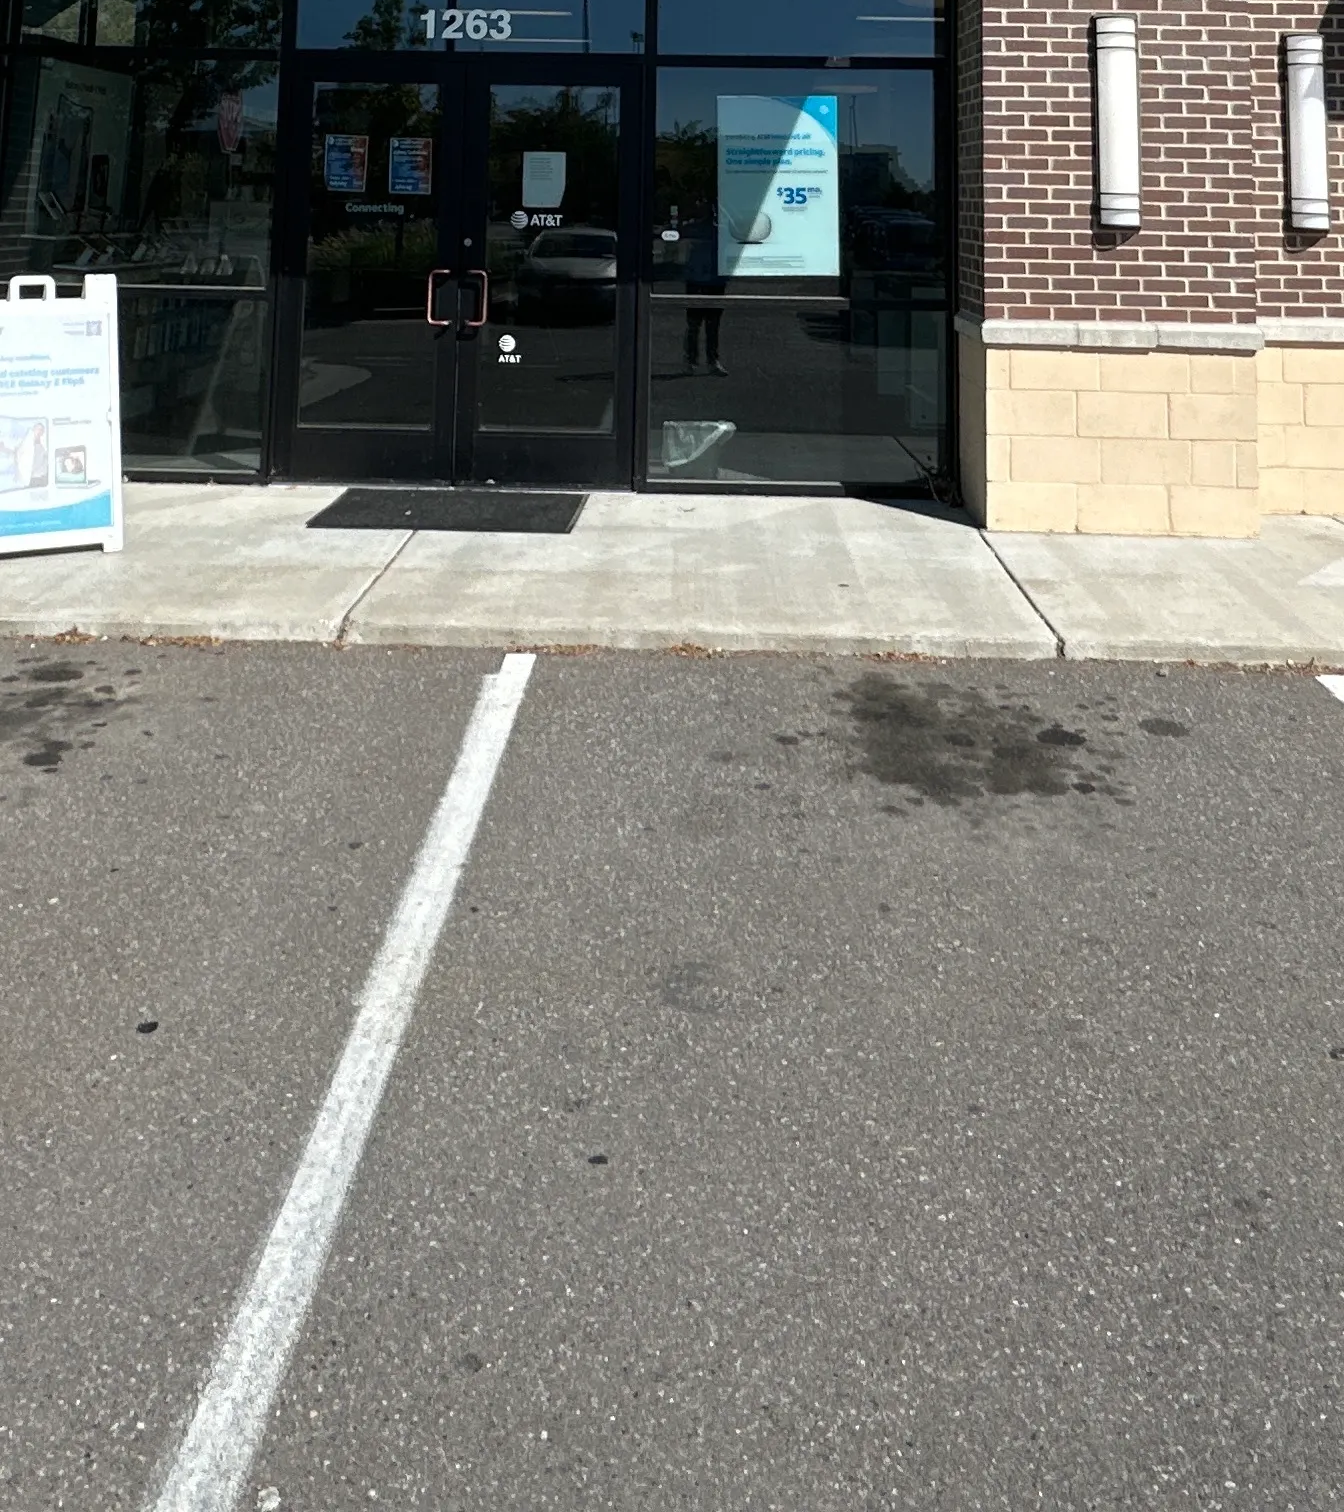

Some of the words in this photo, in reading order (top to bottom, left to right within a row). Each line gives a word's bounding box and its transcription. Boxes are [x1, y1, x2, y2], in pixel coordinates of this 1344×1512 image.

[419, 8, 513, 40] 1263
[776, 186, 807, 205] $35
[345, 202, 404, 216] Connecting
[530, 214, 562, 227] AT&T
[498, 354, 521, 364] AT&T
